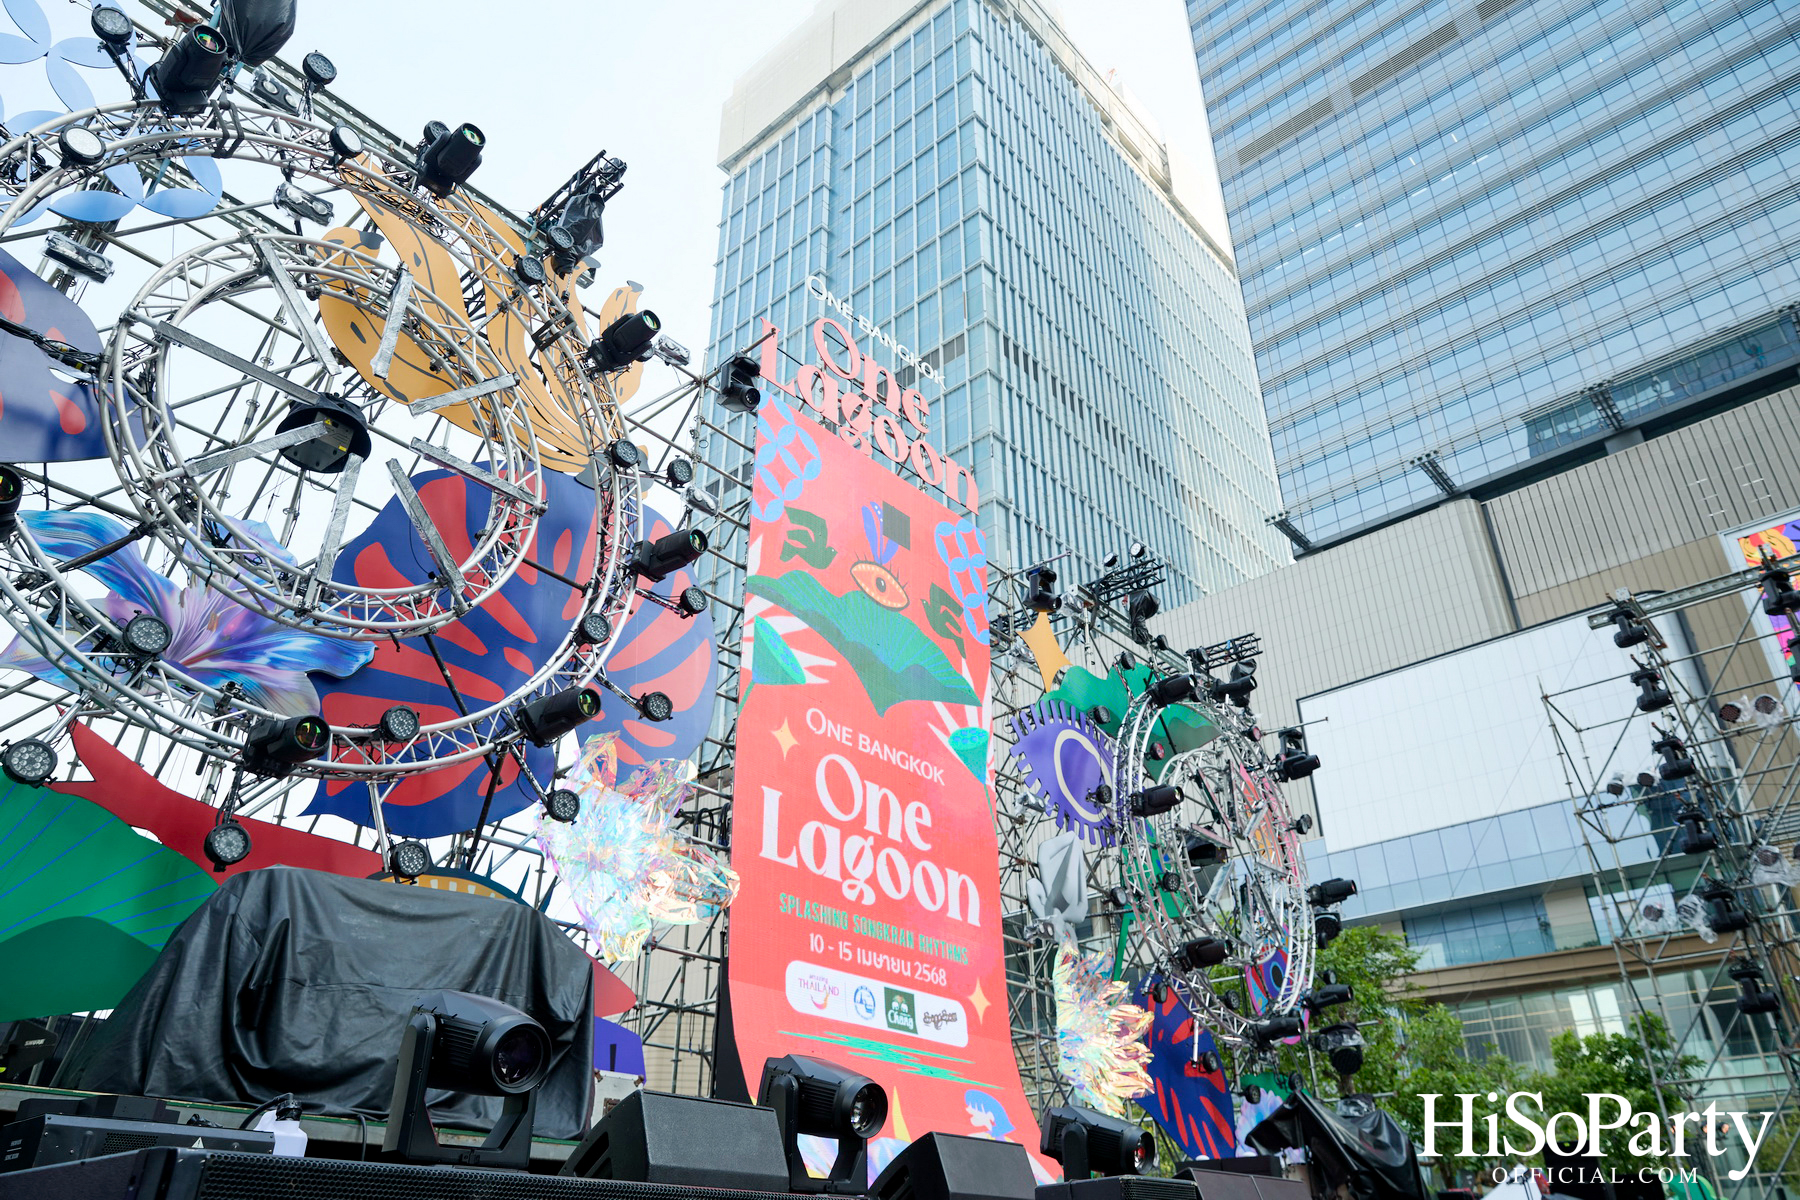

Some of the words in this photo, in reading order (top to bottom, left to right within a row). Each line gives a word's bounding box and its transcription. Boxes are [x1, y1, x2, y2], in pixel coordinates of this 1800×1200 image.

[806, 275, 854, 323] ONE
[858, 314, 947, 390] BANGKOK
[813, 317, 930, 434] One
[759, 317, 979, 516] Lagoon
[805, 707, 853, 746] ONE
[858, 733, 945, 786] BANGKOK
[815, 754, 932, 851] One
[759, 785, 981, 927] Lagoon
[779, 893, 848, 930] SPLASHING
[853, 915, 915, 949] SONGKRAN
[919, 934, 968, 965] RHYTHMS
[809, 933, 824, 953] 10
[838, 940, 852, 961] 15
[857, 947, 911, 977] เมษายน
[914, 961, 947, 987] 2568
[798, 978, 839, 996] THAILAND
[888, 1009, 914, 1030] Chang
